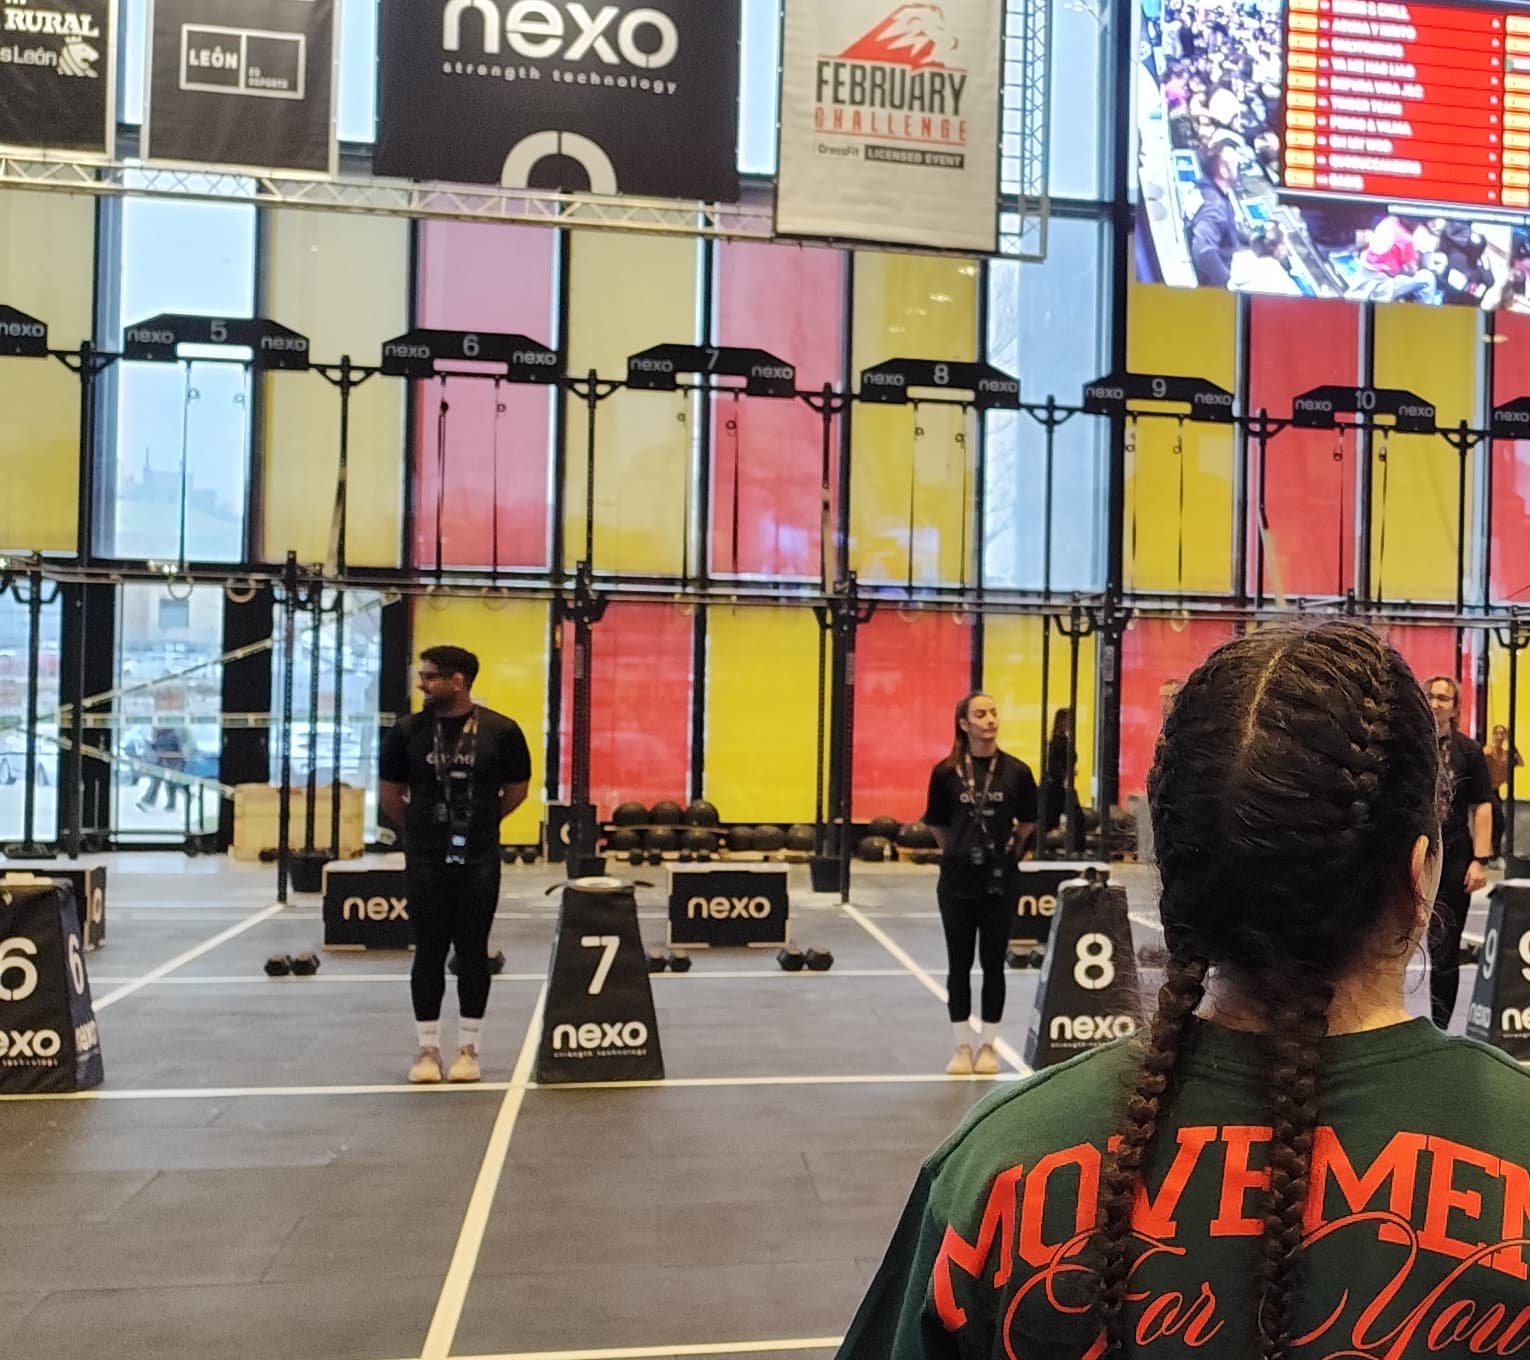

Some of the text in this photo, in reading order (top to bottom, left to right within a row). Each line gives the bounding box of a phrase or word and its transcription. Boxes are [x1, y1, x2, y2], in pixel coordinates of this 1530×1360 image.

[4, 7, 99, 38] RURAL
[0, 44, 57, 67] sLeón
[189, 45, 238, 70] LEÓN
[443, 62, 677, 95] strength technology
[816, 61, 967, 116] FEBRUARY
[815, 107, 967, 142] CHALLENGE
[867, 148, 923, 163] LICENSED
[924, 153, 962, 167] EVENT
[127, 320, 306, 352] nexo 5 nexo
[385, 334, 557, 366] nexo 6 nexo
[630, 349, 794, 380] nexo 7 nexo
[863, 363, 1018, 393] nexo 8 nexo
[1086, 378, 1232, 407] nexo 9 nexo
[1295, 390, 1434, 418] nexo 10 nexo
[1495, 408, 1530, 423] nexo
[343, 895, 410, 922] nex
[687, 895, 771, 921] nexo
[1017, 894, 1057, 917] ne
[0, 936, 38, 1001] 6
[68, 933, 85, 995] 6
[580, 935, 621, 995] 7
[1074, 932, 1115, 990] 8
[1483, 927, 1498, 981] 9
[552, 1021, 648, 1050] nexo
[1050, 1015, 1135, 1041] nexo
